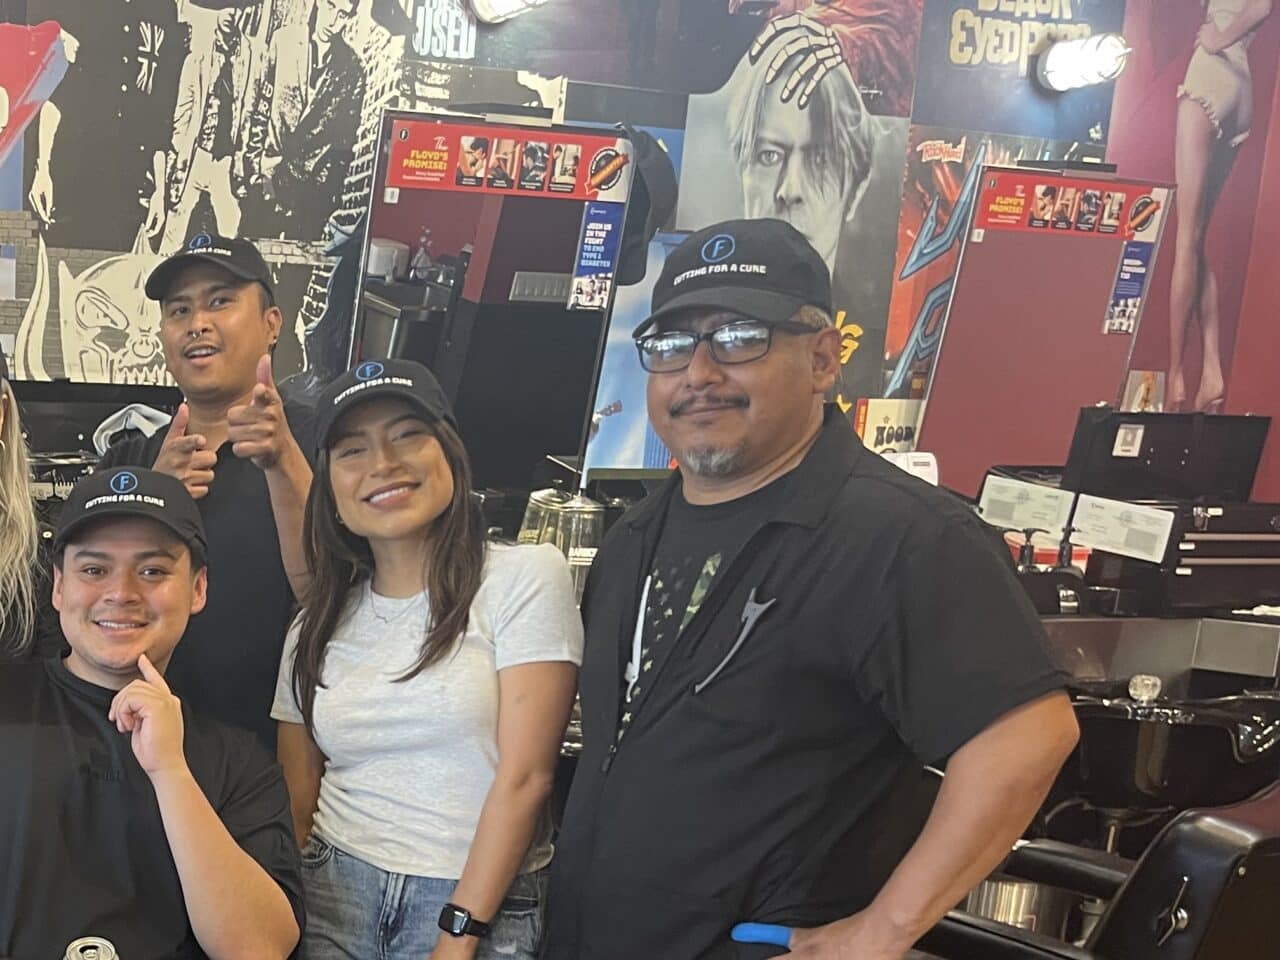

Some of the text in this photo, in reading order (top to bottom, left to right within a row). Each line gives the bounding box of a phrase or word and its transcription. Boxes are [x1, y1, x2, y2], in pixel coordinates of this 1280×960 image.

[673, 263, 767, 286] CUTTING FOR A CURE
[85, 494, 164, 509] CUTTING FOR A CURE
